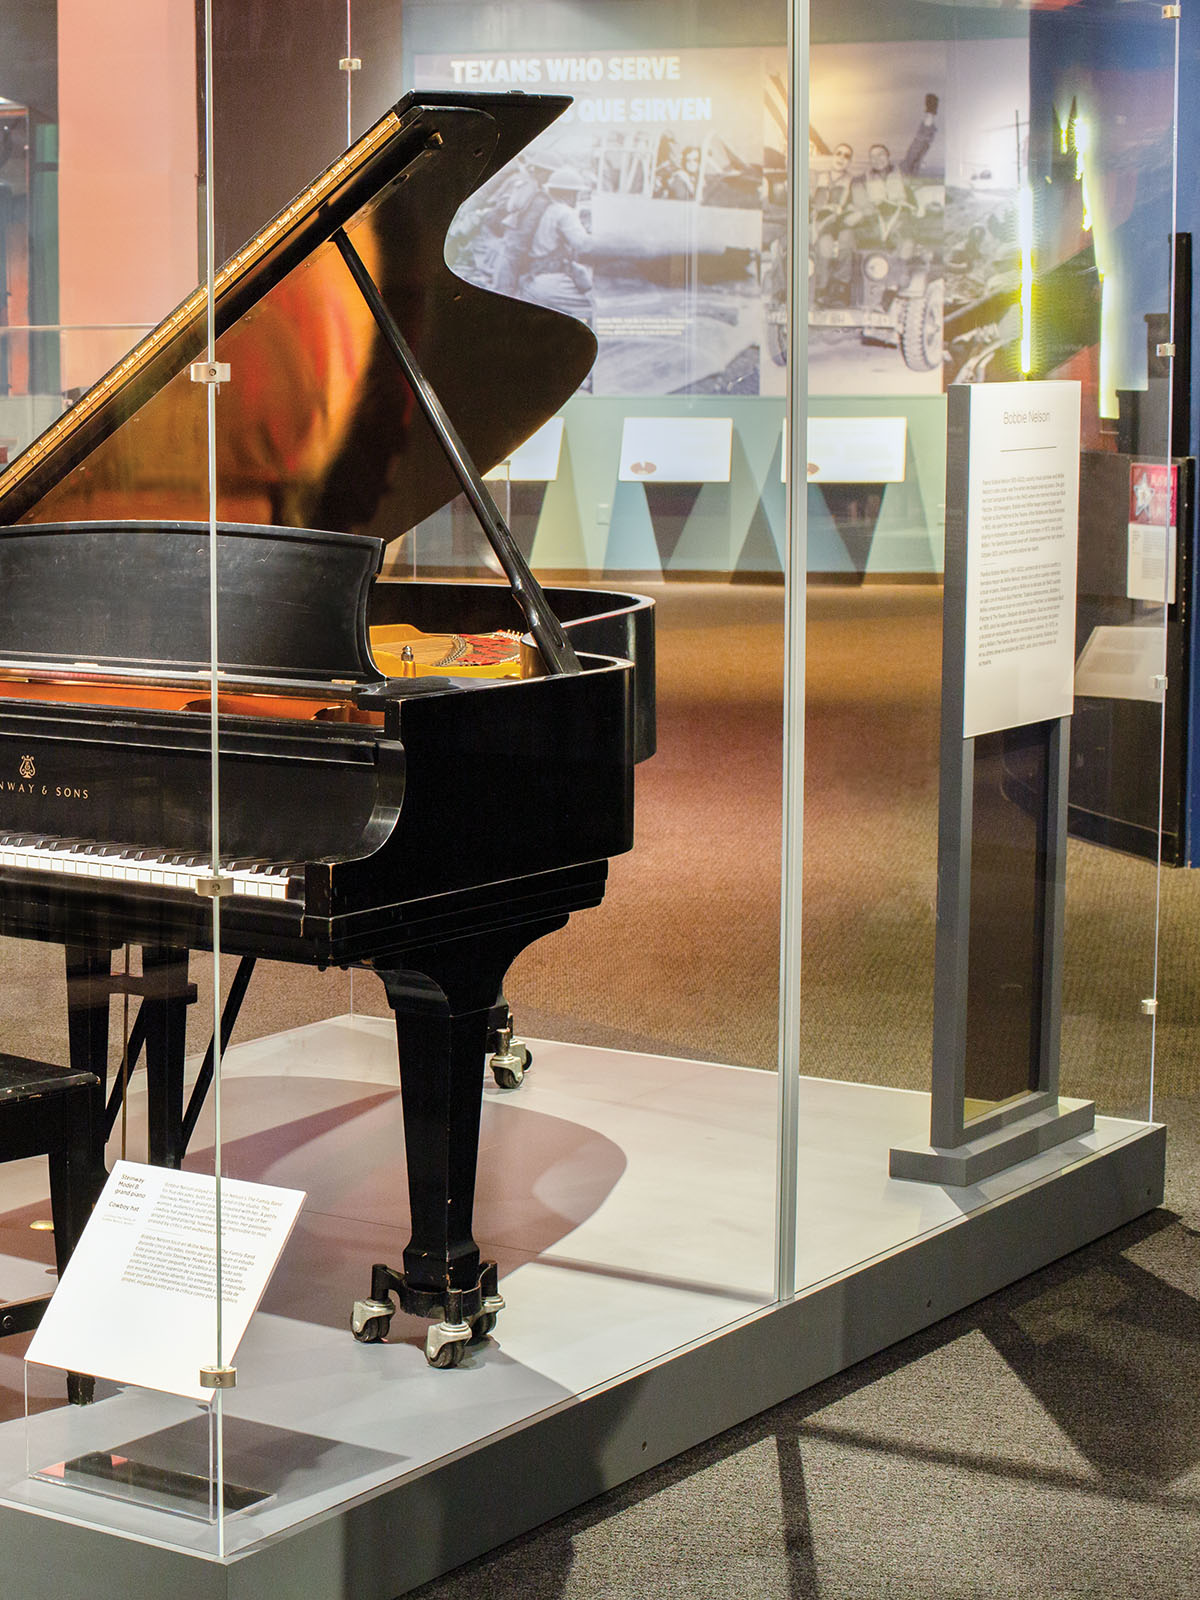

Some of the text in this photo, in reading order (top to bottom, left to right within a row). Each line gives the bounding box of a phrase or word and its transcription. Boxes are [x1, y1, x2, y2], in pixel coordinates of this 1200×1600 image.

[451, 56, 681, 84] TEXANS WHO SERVE
[579, 99, 632, 124] QUE
[629, 97, 713, 123] SIRVEN
[1003, 410, 1028, 425] Bobbie
[41, 785, 48, 795] &
[55, 786, 89, 800] SONS
[121, 1174, 146, 1183] Steinway
[114, 1188, 131, 1196] grand
[108, 1201, 131, 1211] Cowboy
